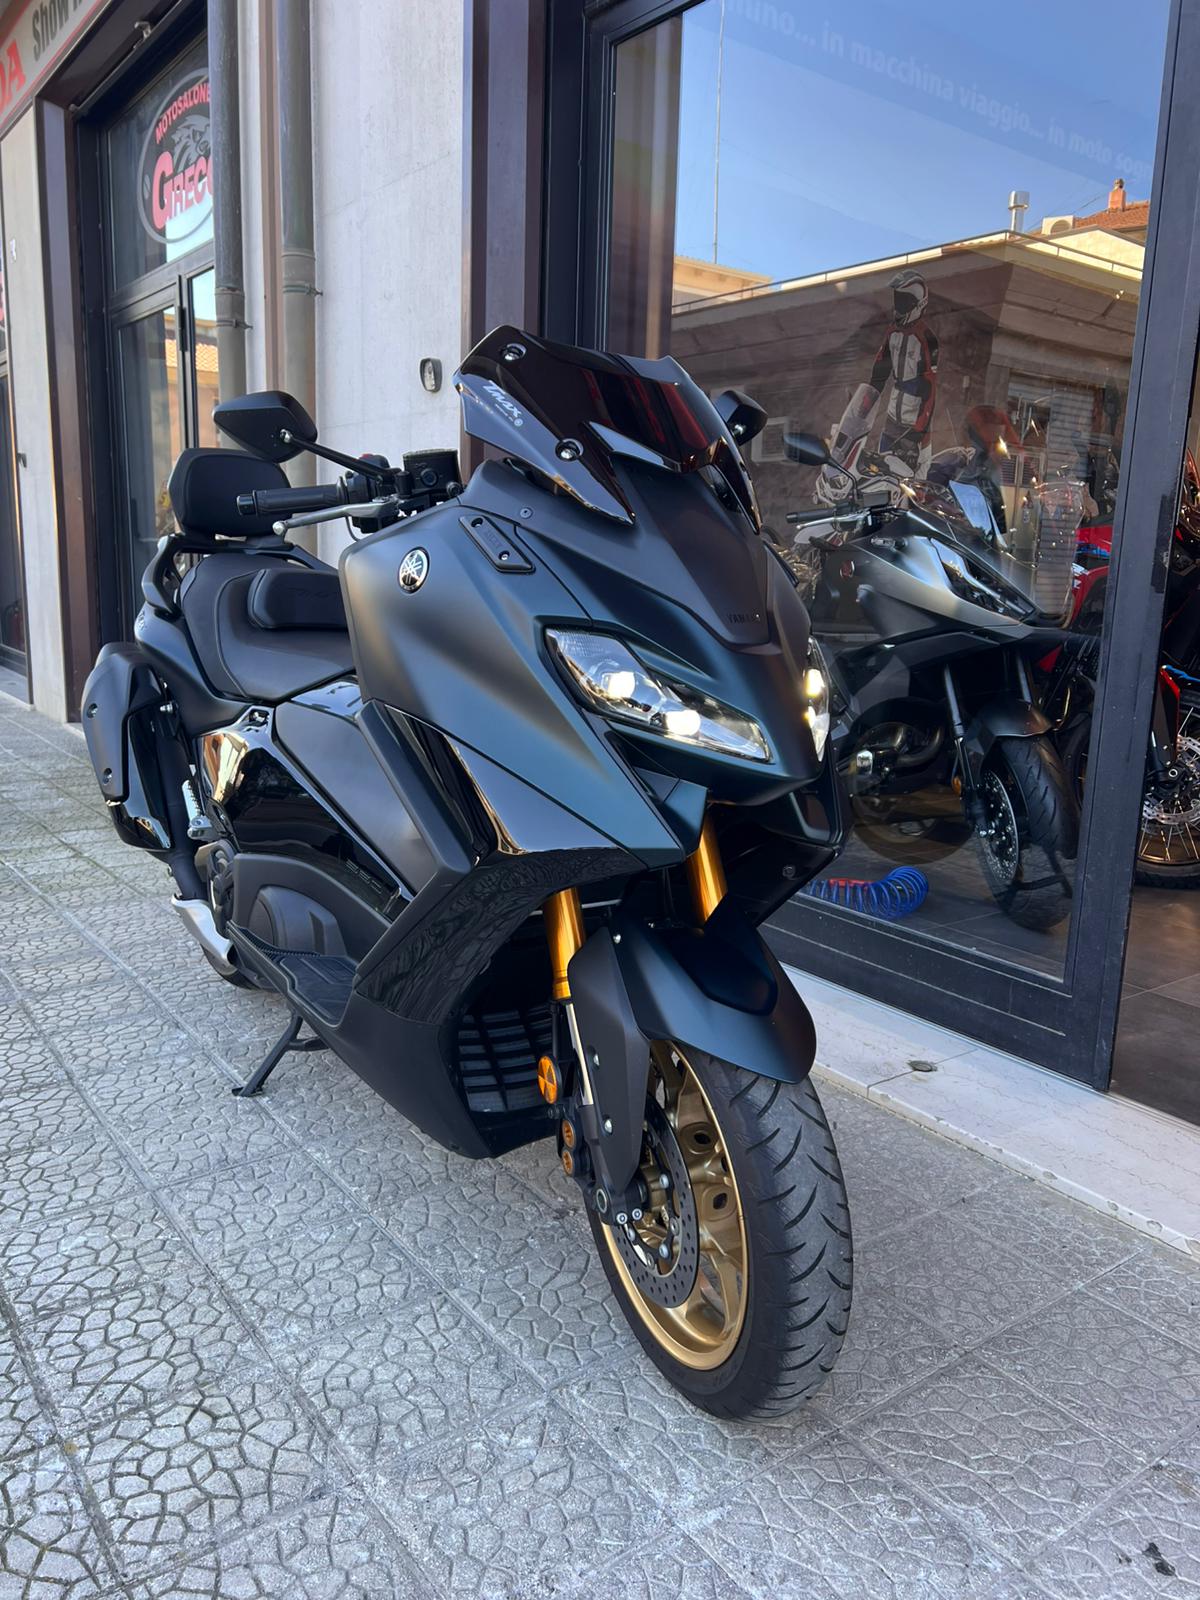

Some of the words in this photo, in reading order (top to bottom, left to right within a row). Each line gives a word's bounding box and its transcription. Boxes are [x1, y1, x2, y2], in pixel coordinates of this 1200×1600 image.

[822, 19, 845, 57] in
[849, 41, 954, 102] macchina
[1047, 115, 1064, 148] in
